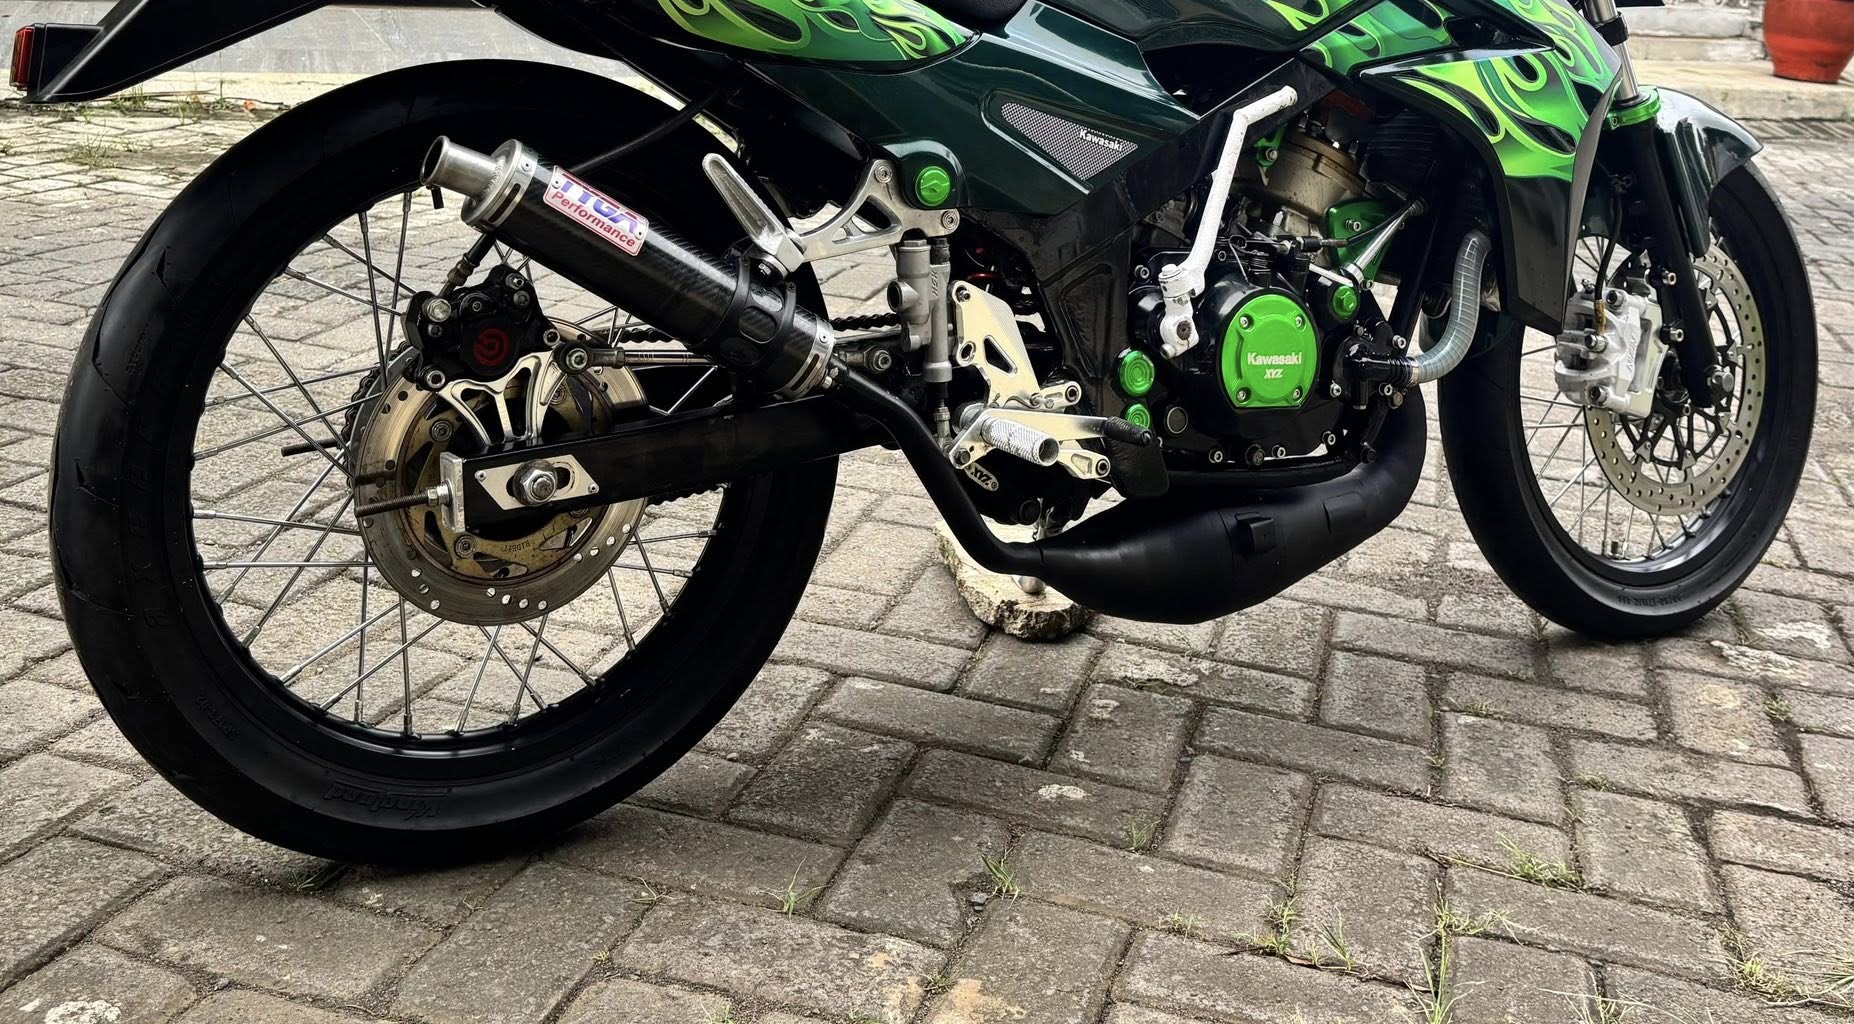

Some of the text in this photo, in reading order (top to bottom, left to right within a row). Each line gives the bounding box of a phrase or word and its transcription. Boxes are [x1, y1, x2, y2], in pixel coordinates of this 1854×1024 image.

[1079, 128, 1123, 151] Kawasaki
[551, 191, 636, 248] Performance
[1247, 351, 1302, 365] Kawasaki
[1263, 368, 1284, 379] XYZ
